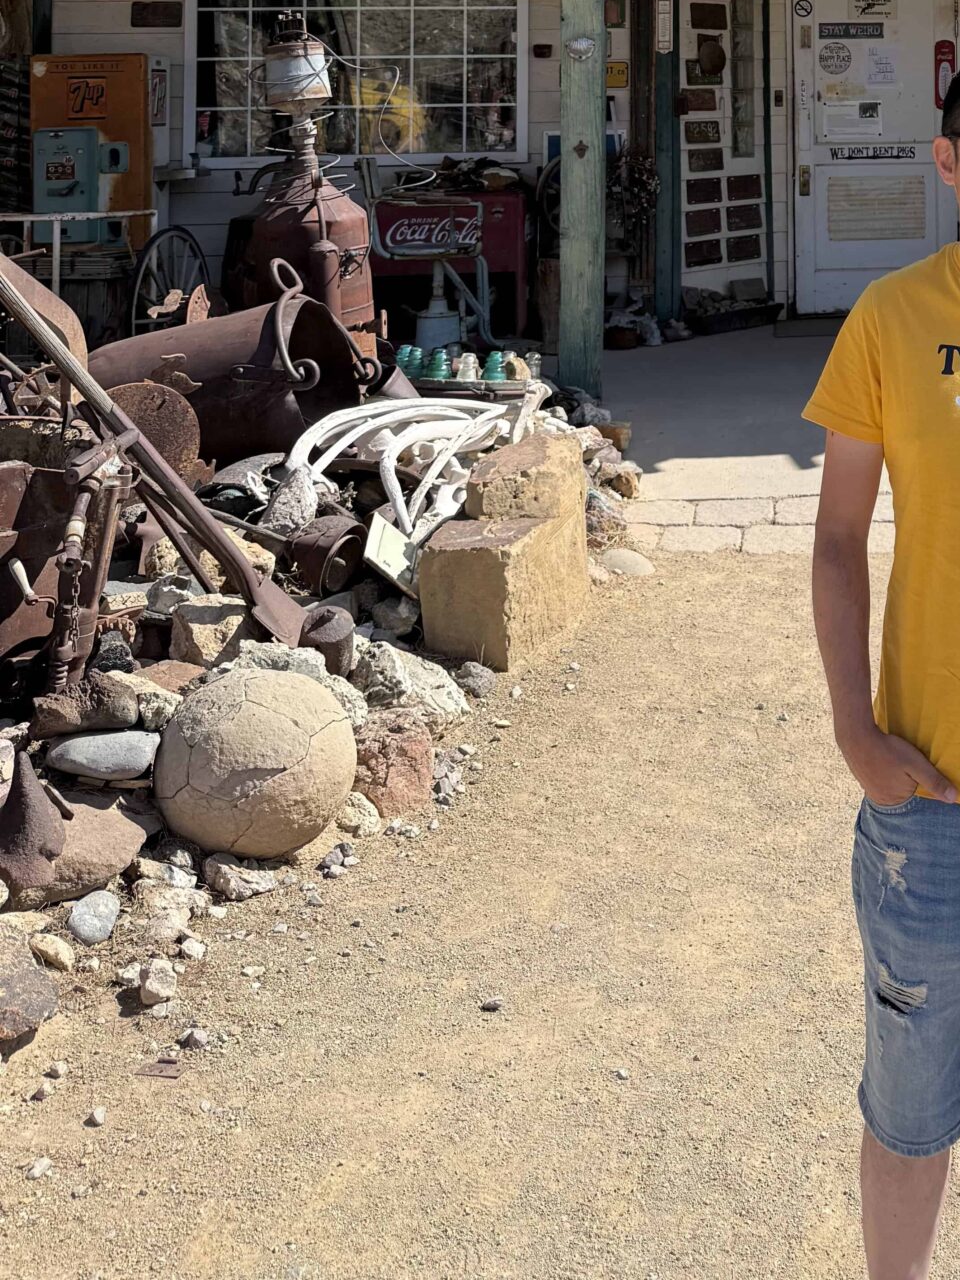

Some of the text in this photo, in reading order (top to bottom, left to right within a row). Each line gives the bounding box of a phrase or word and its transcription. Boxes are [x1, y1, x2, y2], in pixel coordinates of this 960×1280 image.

[821, 24, 881, 36] STAY WEIRD
[830, 148, 845, 160] WE
[873, 147, 894, 159] RENT
[897, 147, 916, 159] PIGS
